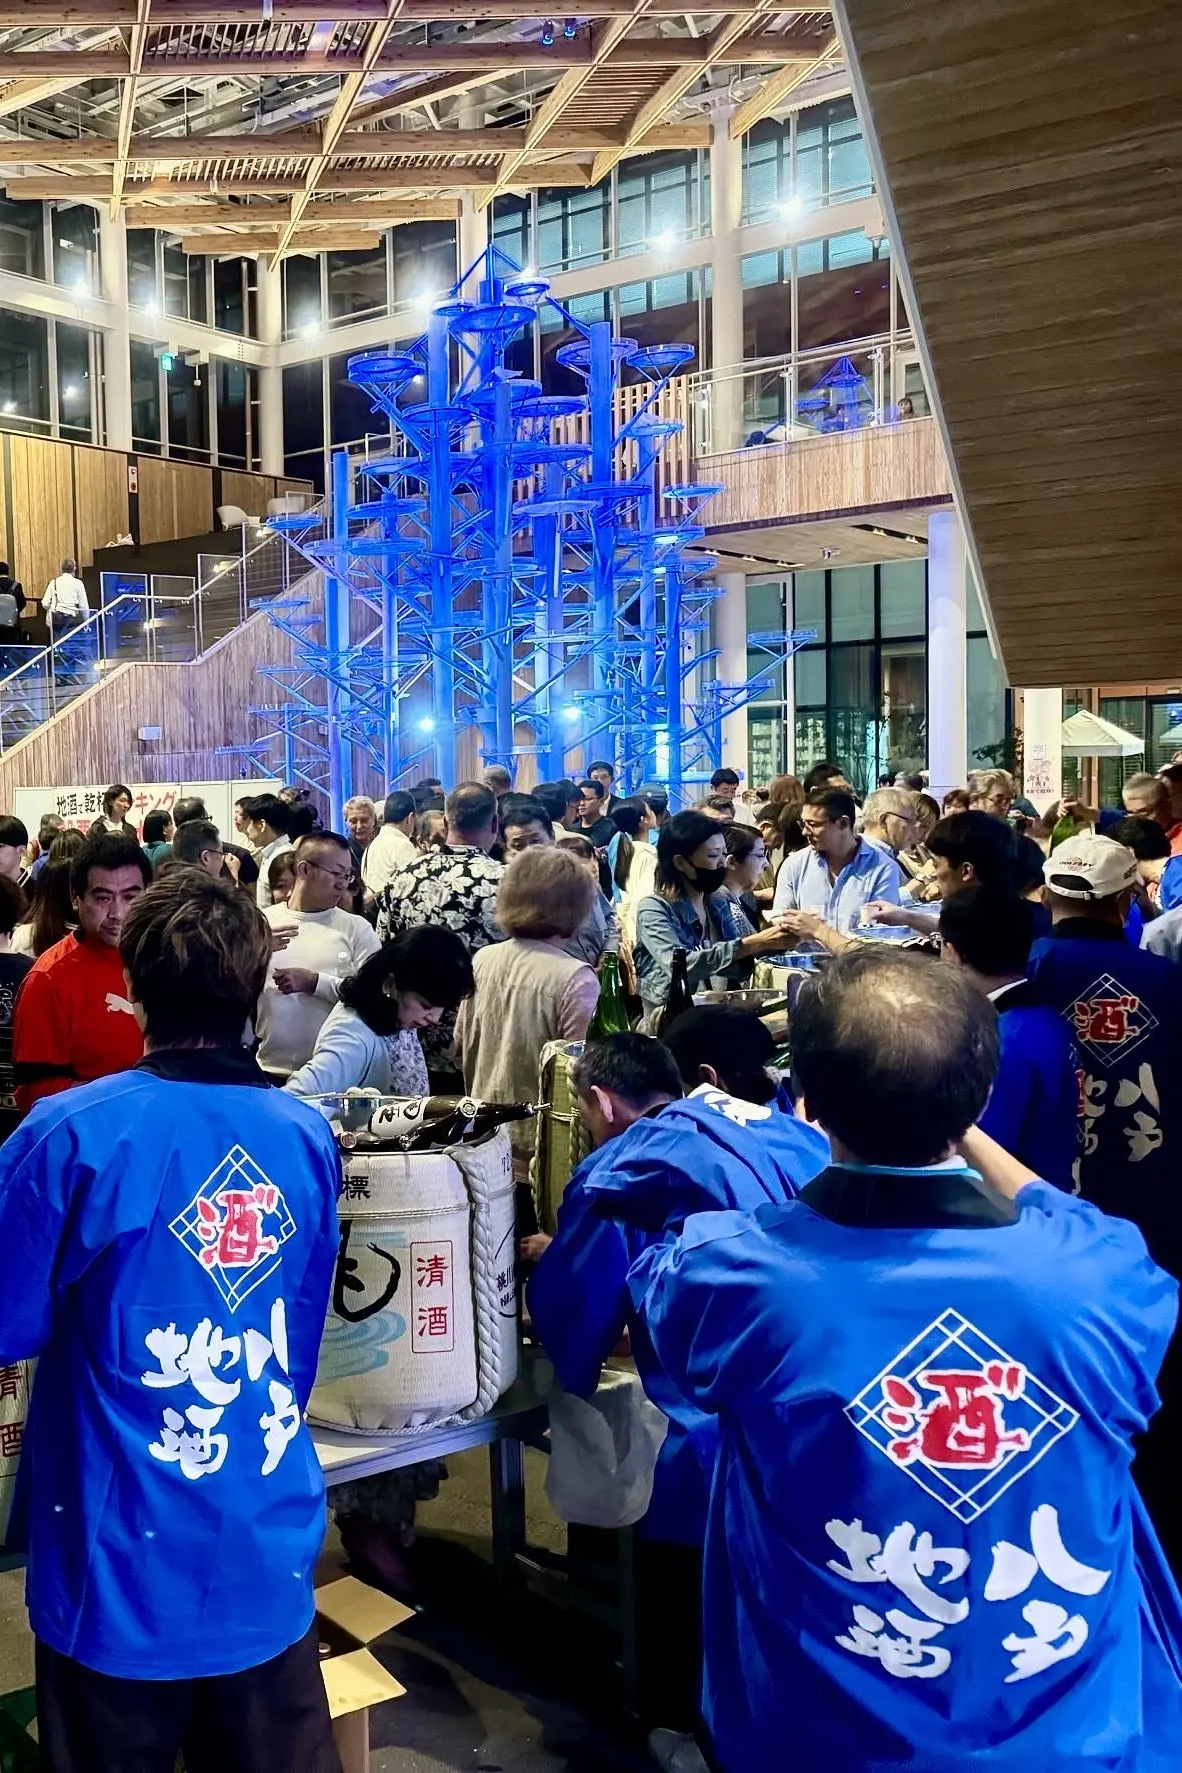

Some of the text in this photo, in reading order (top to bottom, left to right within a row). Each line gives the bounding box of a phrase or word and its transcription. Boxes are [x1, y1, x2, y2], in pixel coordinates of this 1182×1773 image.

[416, 1253, 450, 1337] 清酒
[141, 1317, 241, 1481] 地酒
[825, 1517, 970, 1679] 地酒
[983, 1503, 1111, 1683] 八戸
